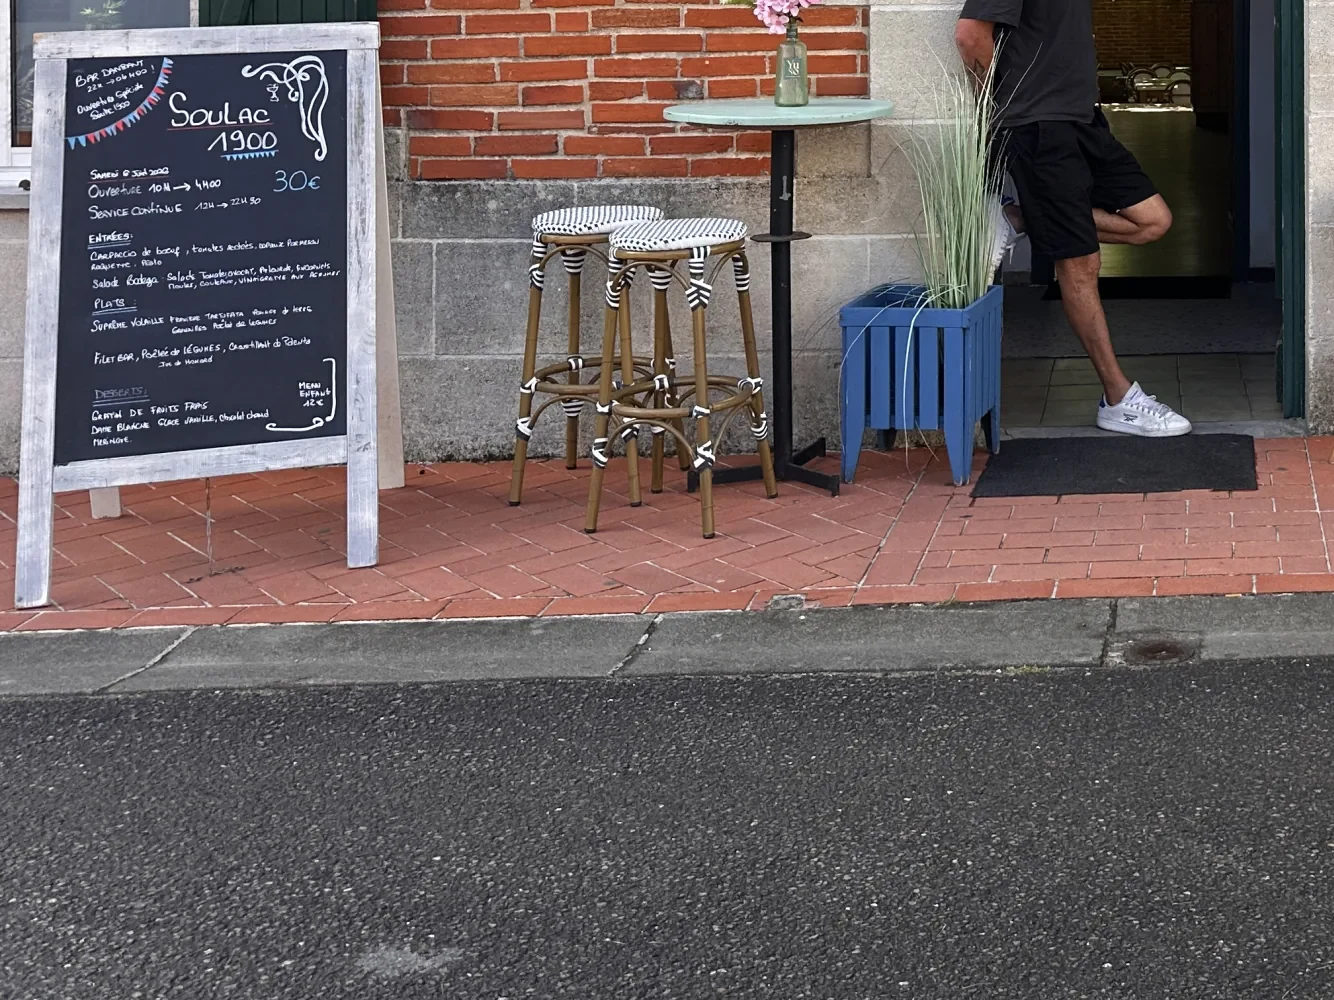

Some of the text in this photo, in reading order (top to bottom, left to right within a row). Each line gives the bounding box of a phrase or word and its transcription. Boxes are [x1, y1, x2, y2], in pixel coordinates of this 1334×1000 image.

[75, 73, 100, 88] BAR
[207, 130, 278, 151] 1900
[195, 178, 222, 191] 4H00
[273, 170, 321, 192] 30€
[142, 247, 152, 257] de
[129, 408, 144, 418] DE
